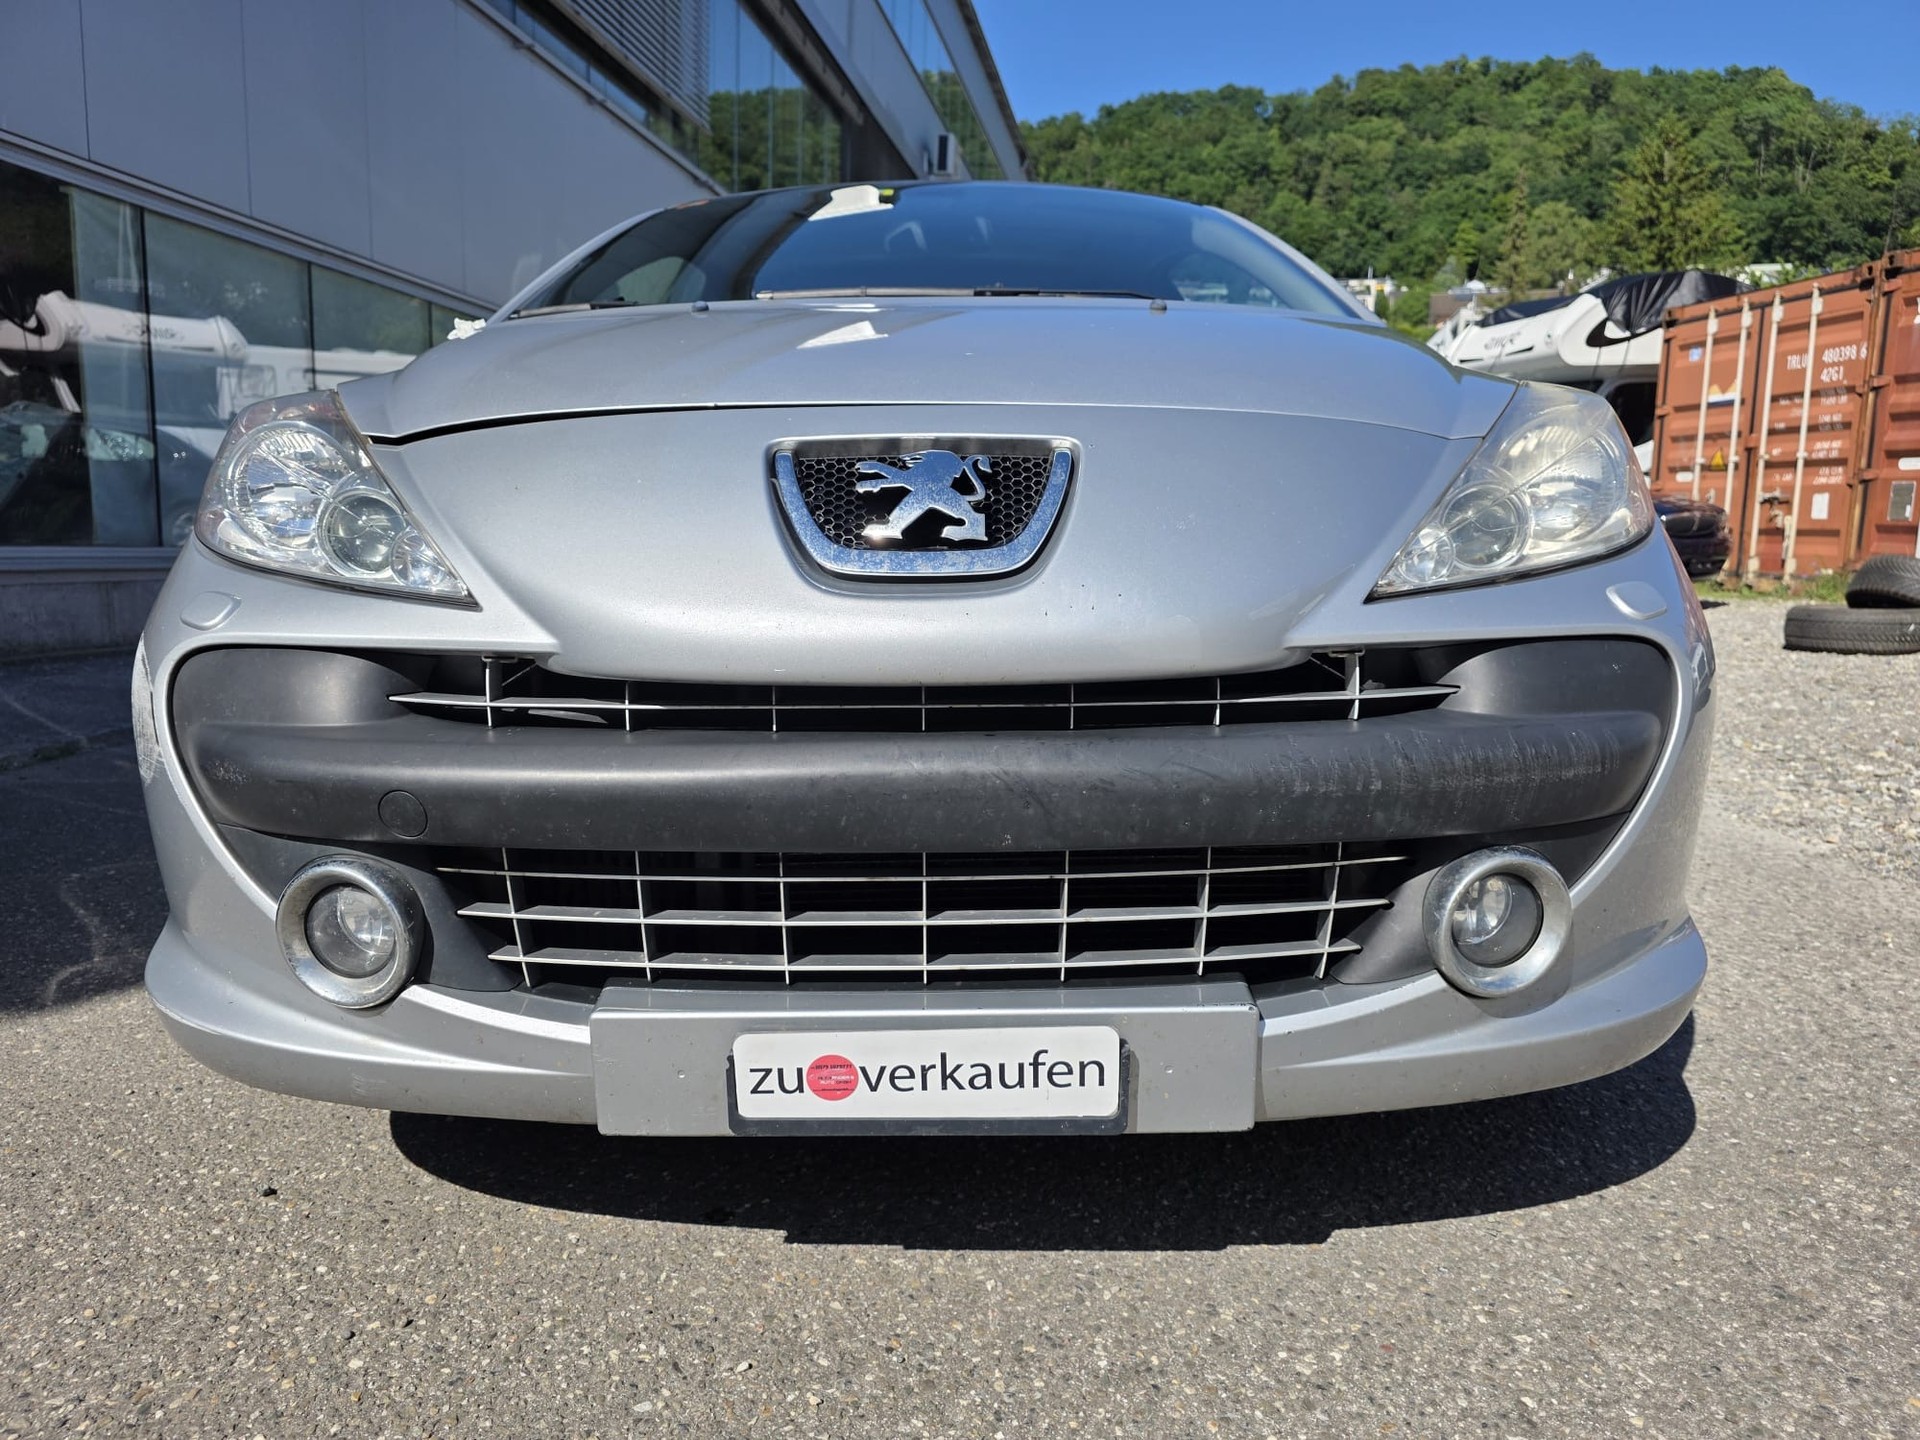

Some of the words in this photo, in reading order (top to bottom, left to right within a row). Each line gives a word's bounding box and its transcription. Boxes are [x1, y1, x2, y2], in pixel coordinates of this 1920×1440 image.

[1786, 353, 1810, 370] TRLU
[1822, 344, 1857, 364] 480398
[1860, 341, 1868, 360] 6
[749, 1067, 804, 1094] zu
[858, 1049, 1105, 1093] verkaufen
